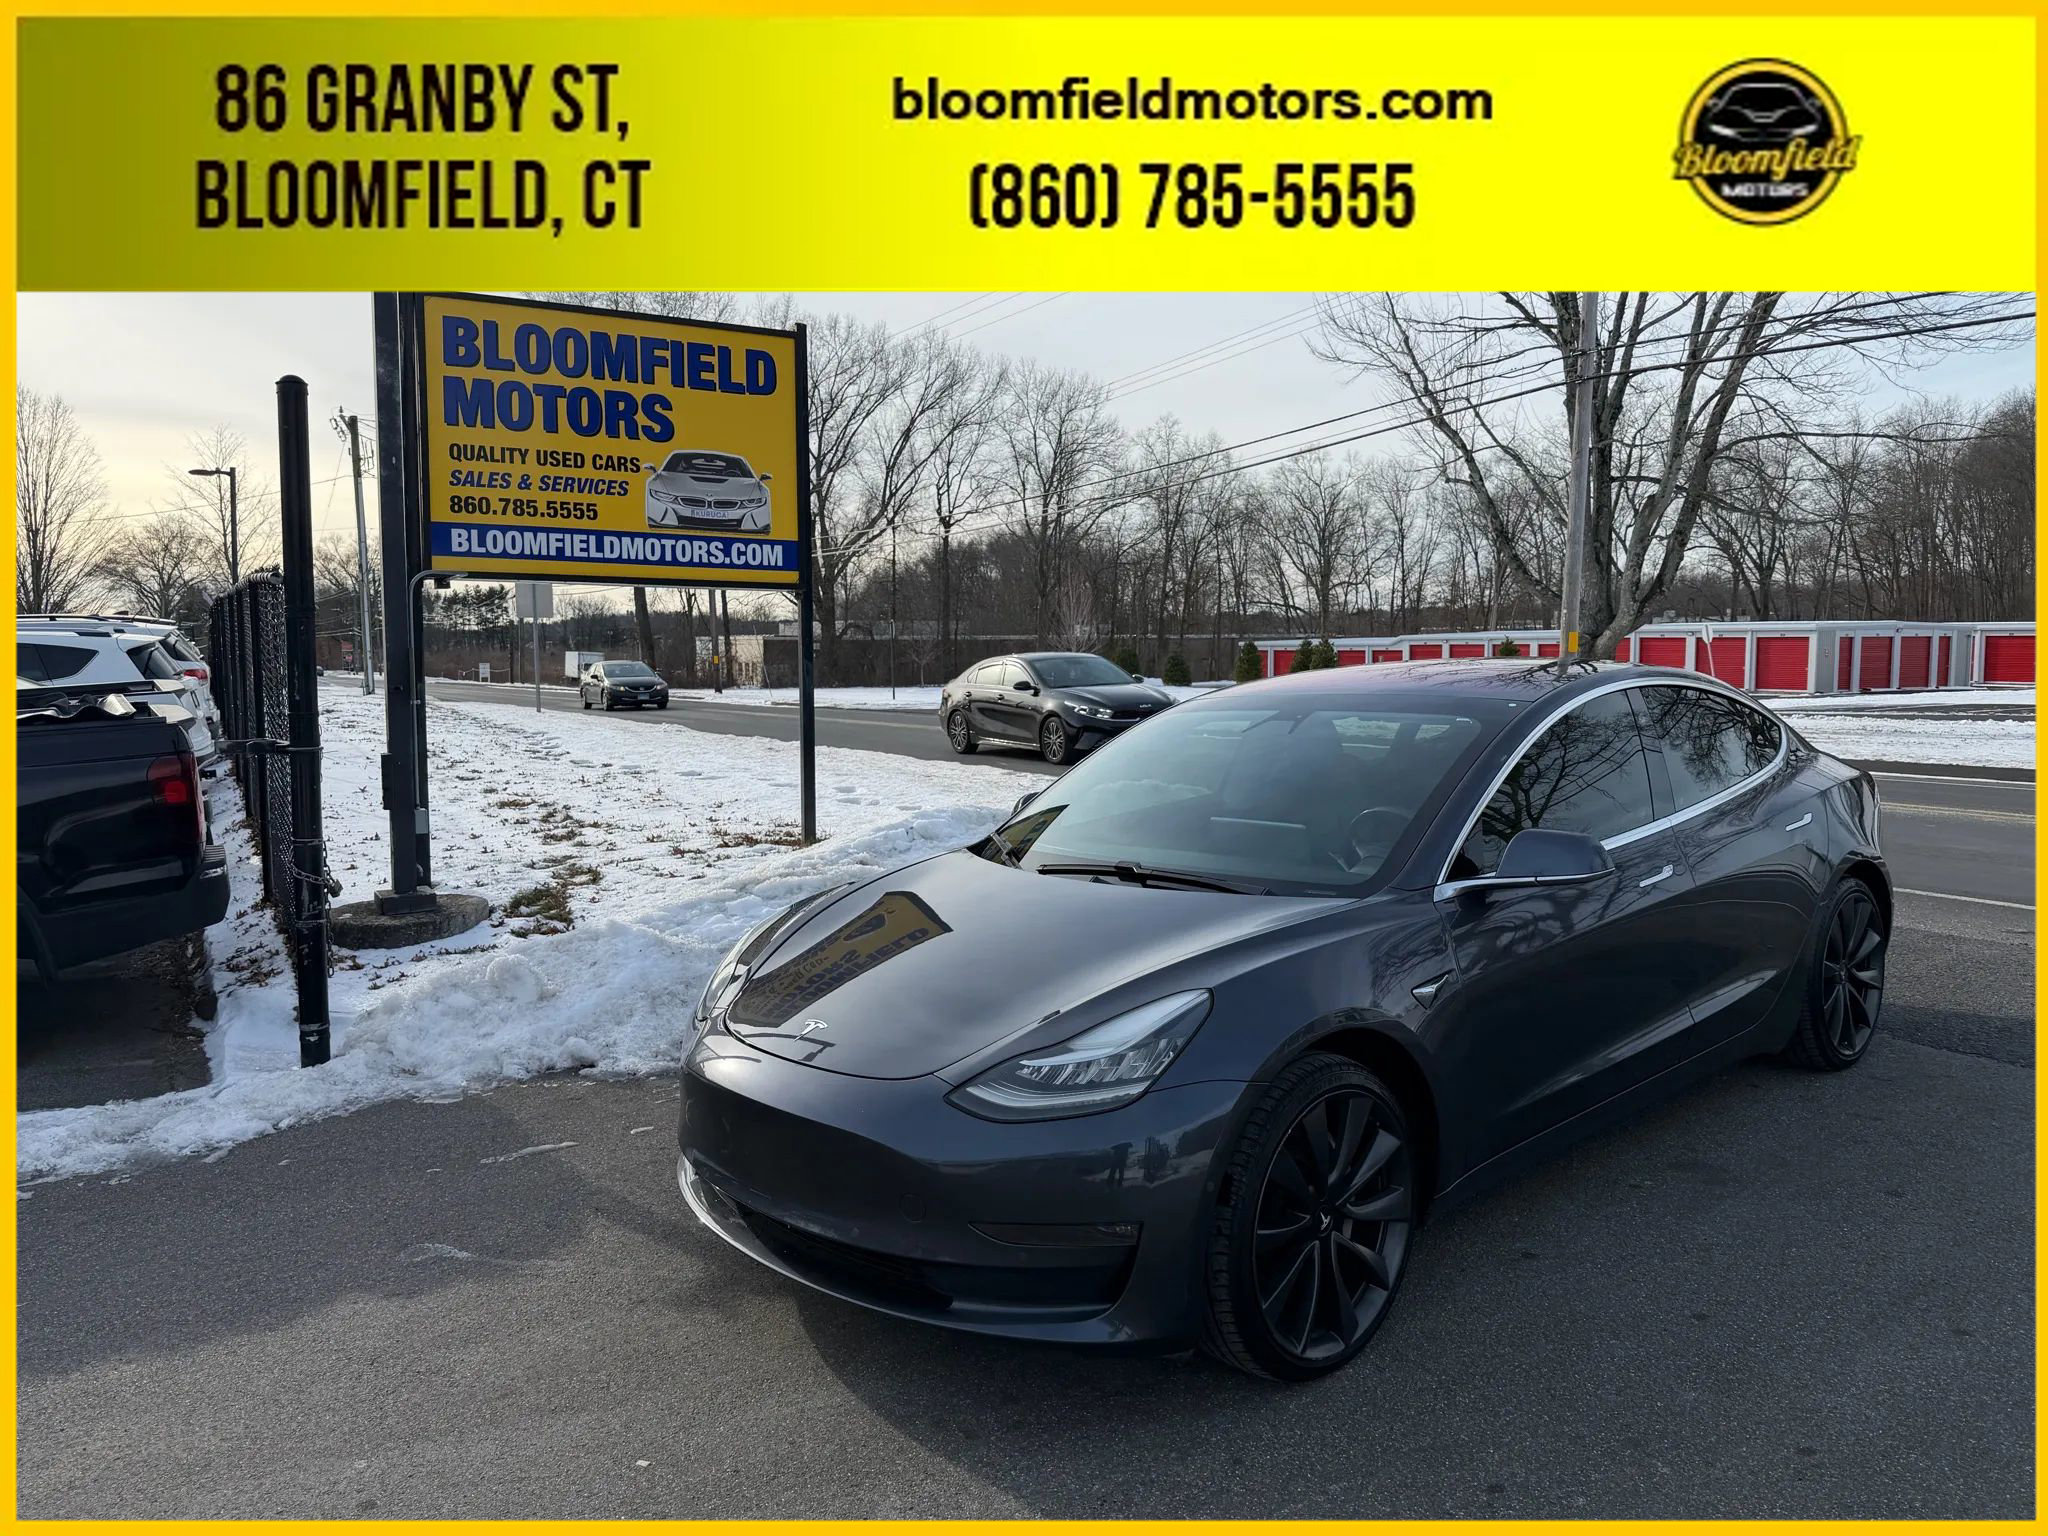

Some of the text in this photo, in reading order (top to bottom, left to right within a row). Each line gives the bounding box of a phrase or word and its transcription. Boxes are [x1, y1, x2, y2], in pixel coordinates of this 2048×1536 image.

[442, 315, 777, 396] BLOOMFIELD
[442, 375, 676, 443] MOTORS
[449, 443, 641, 473] QUALITY USED CARS
[449, 469, 630, 497] SALES & SERVICES
[449, 495, 598, 521] 860.785.5555
[450, 527, 784, 567] BLOOMFIELDMOTORS.COM
